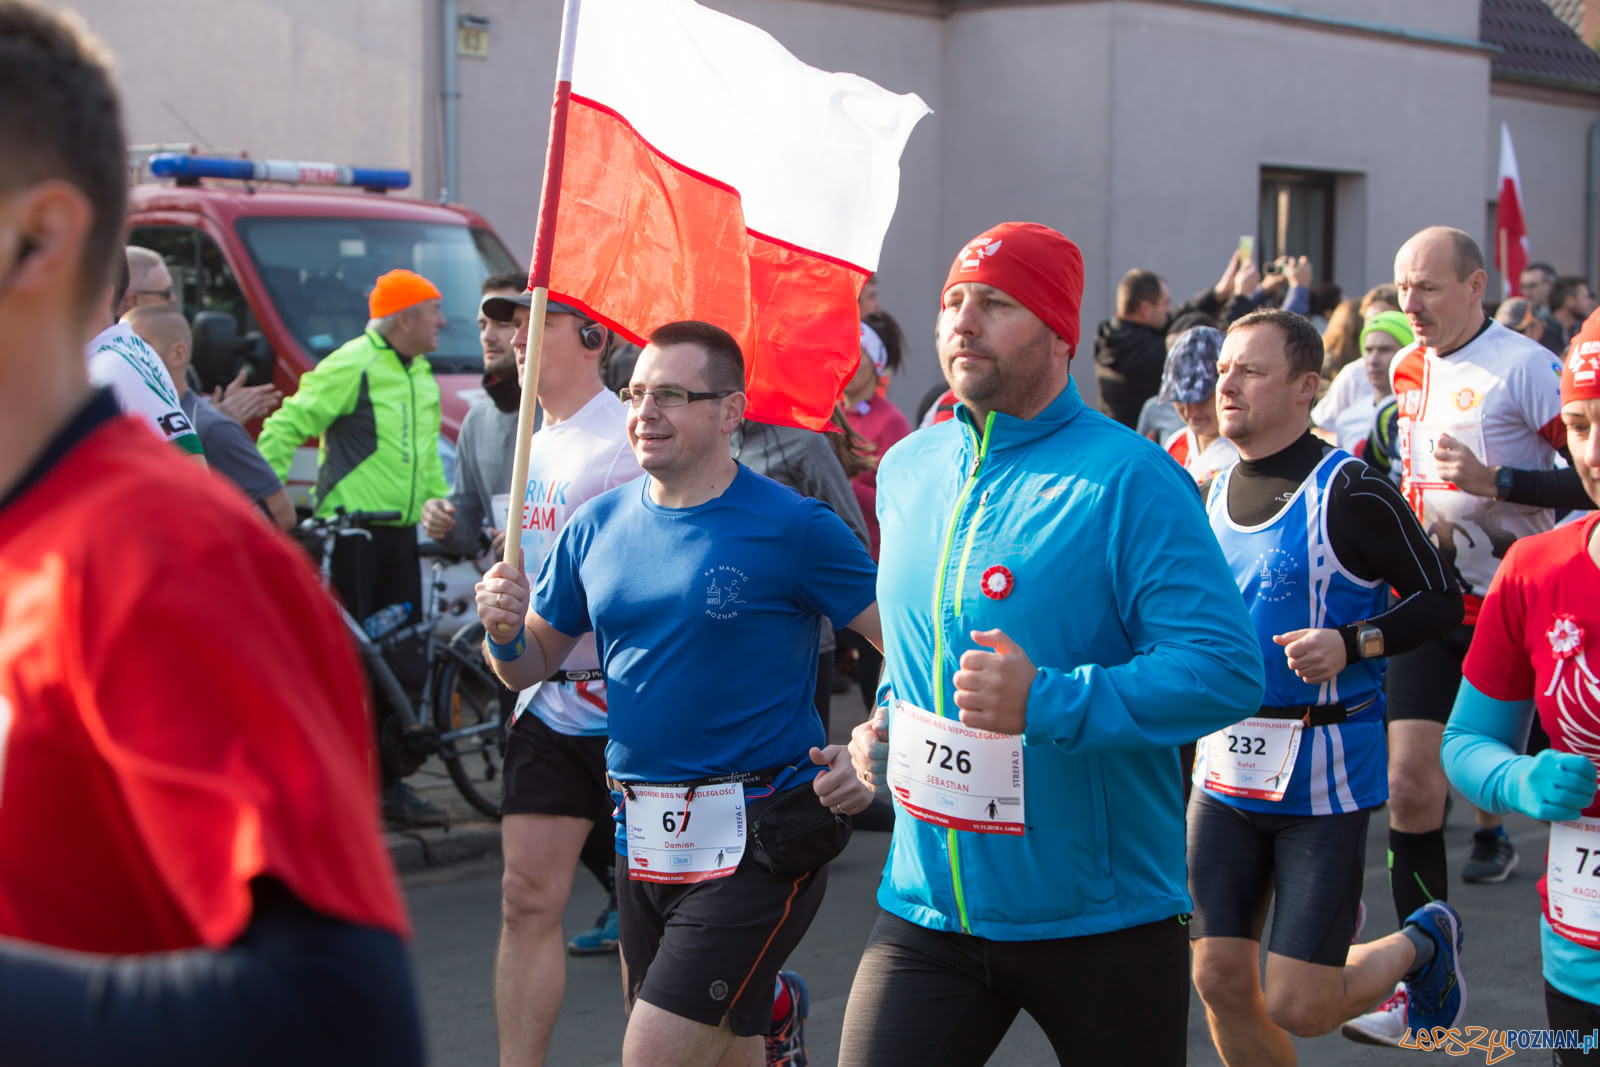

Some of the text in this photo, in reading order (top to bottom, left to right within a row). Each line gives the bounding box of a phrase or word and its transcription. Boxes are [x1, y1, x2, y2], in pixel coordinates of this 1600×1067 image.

[525, 480, 571, 504] RNIK
[522, 506, 555, 531] EAM
[719, 565, 749, 582] MANIAC
[933, 720, 947, 731] BIEG
[1228, 735, 1266, 755] 232
[925, 740, 972, 775] 726
[926, 775, 969, 792] SEBASTIAN
[1012, 759, 1020, 788] STREFA
[660, 791, 674, 799] BIEG
[662, 811, 691, 833] 67
[735, 811, 743, 838] STREFA
[664, 841, 695, 849] Damian
[1576, 847, 1600, 877] 72
[1572, 887, 1600, 899] MAGD
